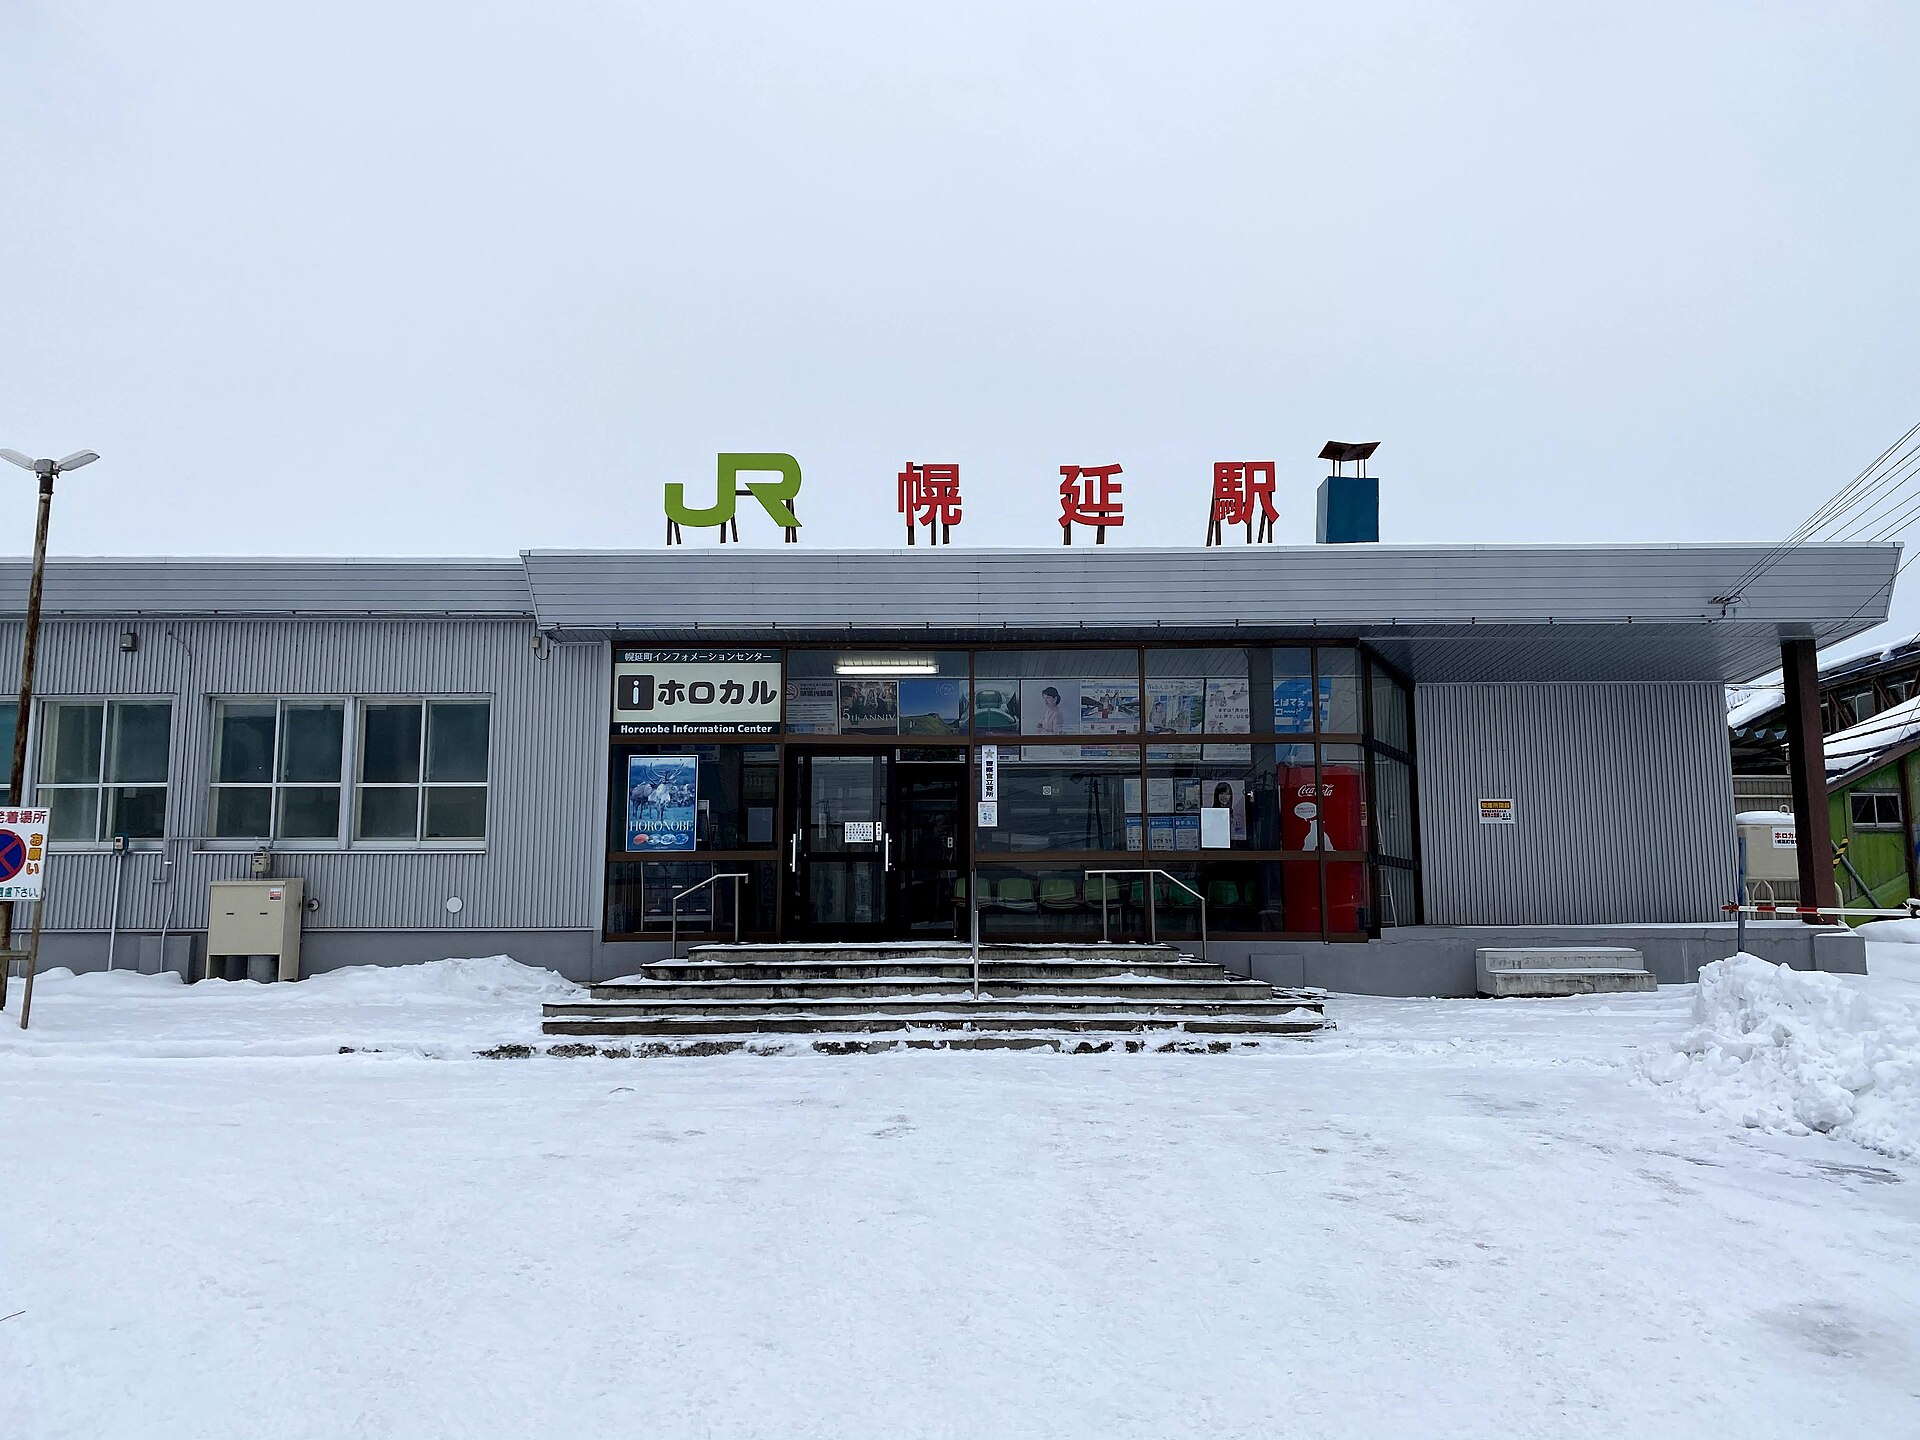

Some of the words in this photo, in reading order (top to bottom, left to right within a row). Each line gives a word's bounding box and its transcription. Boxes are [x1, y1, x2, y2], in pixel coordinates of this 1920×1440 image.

[665, 453, 802, 528] JR
[898, 461, 1280, 527] 幌延駅
[624, 652, 772, 662] 幌延町インフォメーションセンター
[657, 679, 778, 706] ホロカル
[620, 725, 670, 734] Horonobe
[673, 725, 735, 734] Information
[737, 725, 773, 734] Center
[629, 820, 694, 832] HORONOBE
[26, 833, 44, 875] お願い
